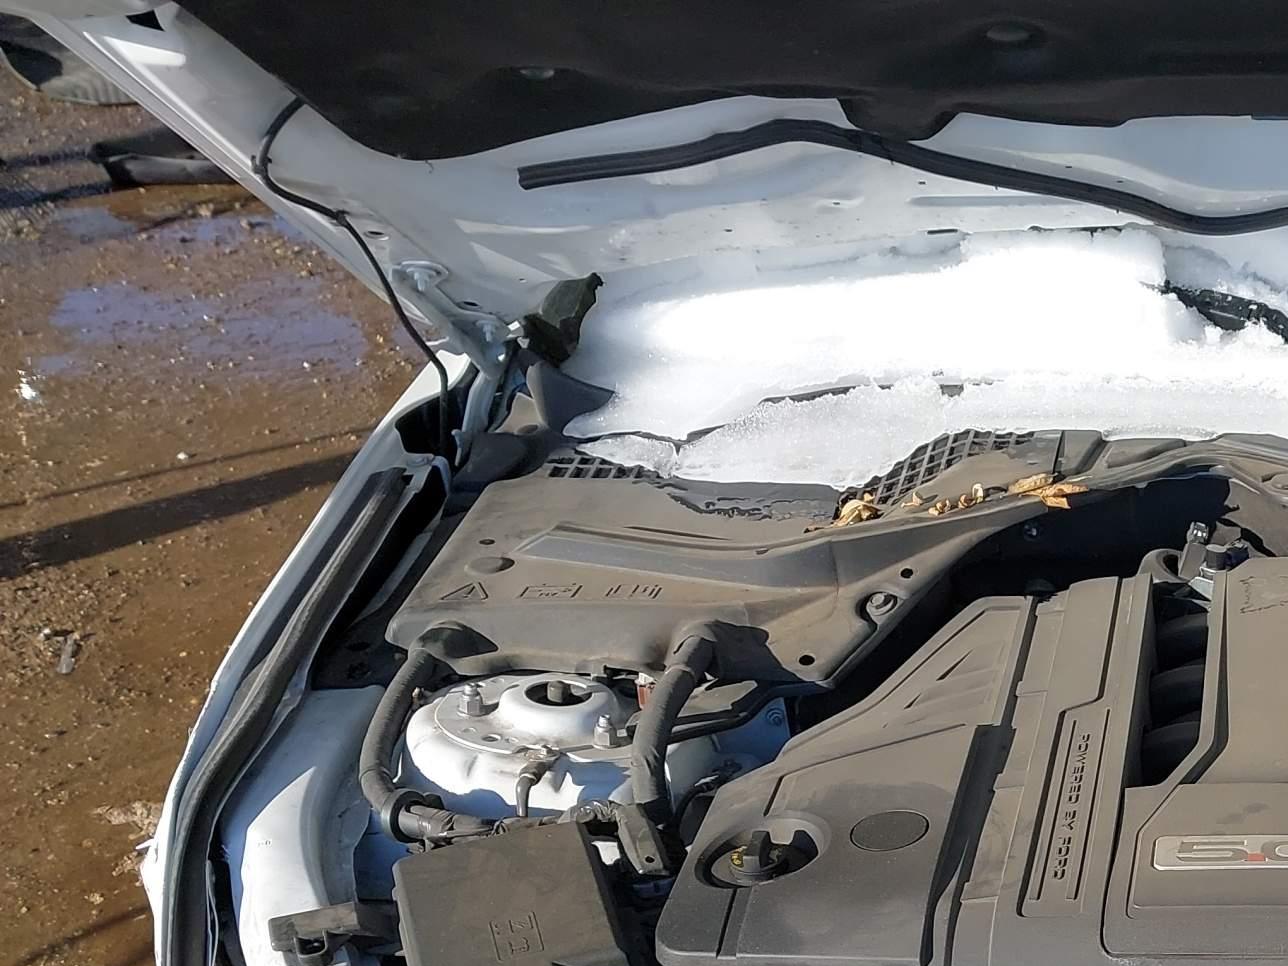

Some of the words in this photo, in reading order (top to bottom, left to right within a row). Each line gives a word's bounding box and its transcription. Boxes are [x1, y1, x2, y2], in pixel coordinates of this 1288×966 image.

[1068, 733, 1091, 805] POWERED
[1062, 810, 1077, 831] BY
[1053, 836, 1072, 880] FORD
